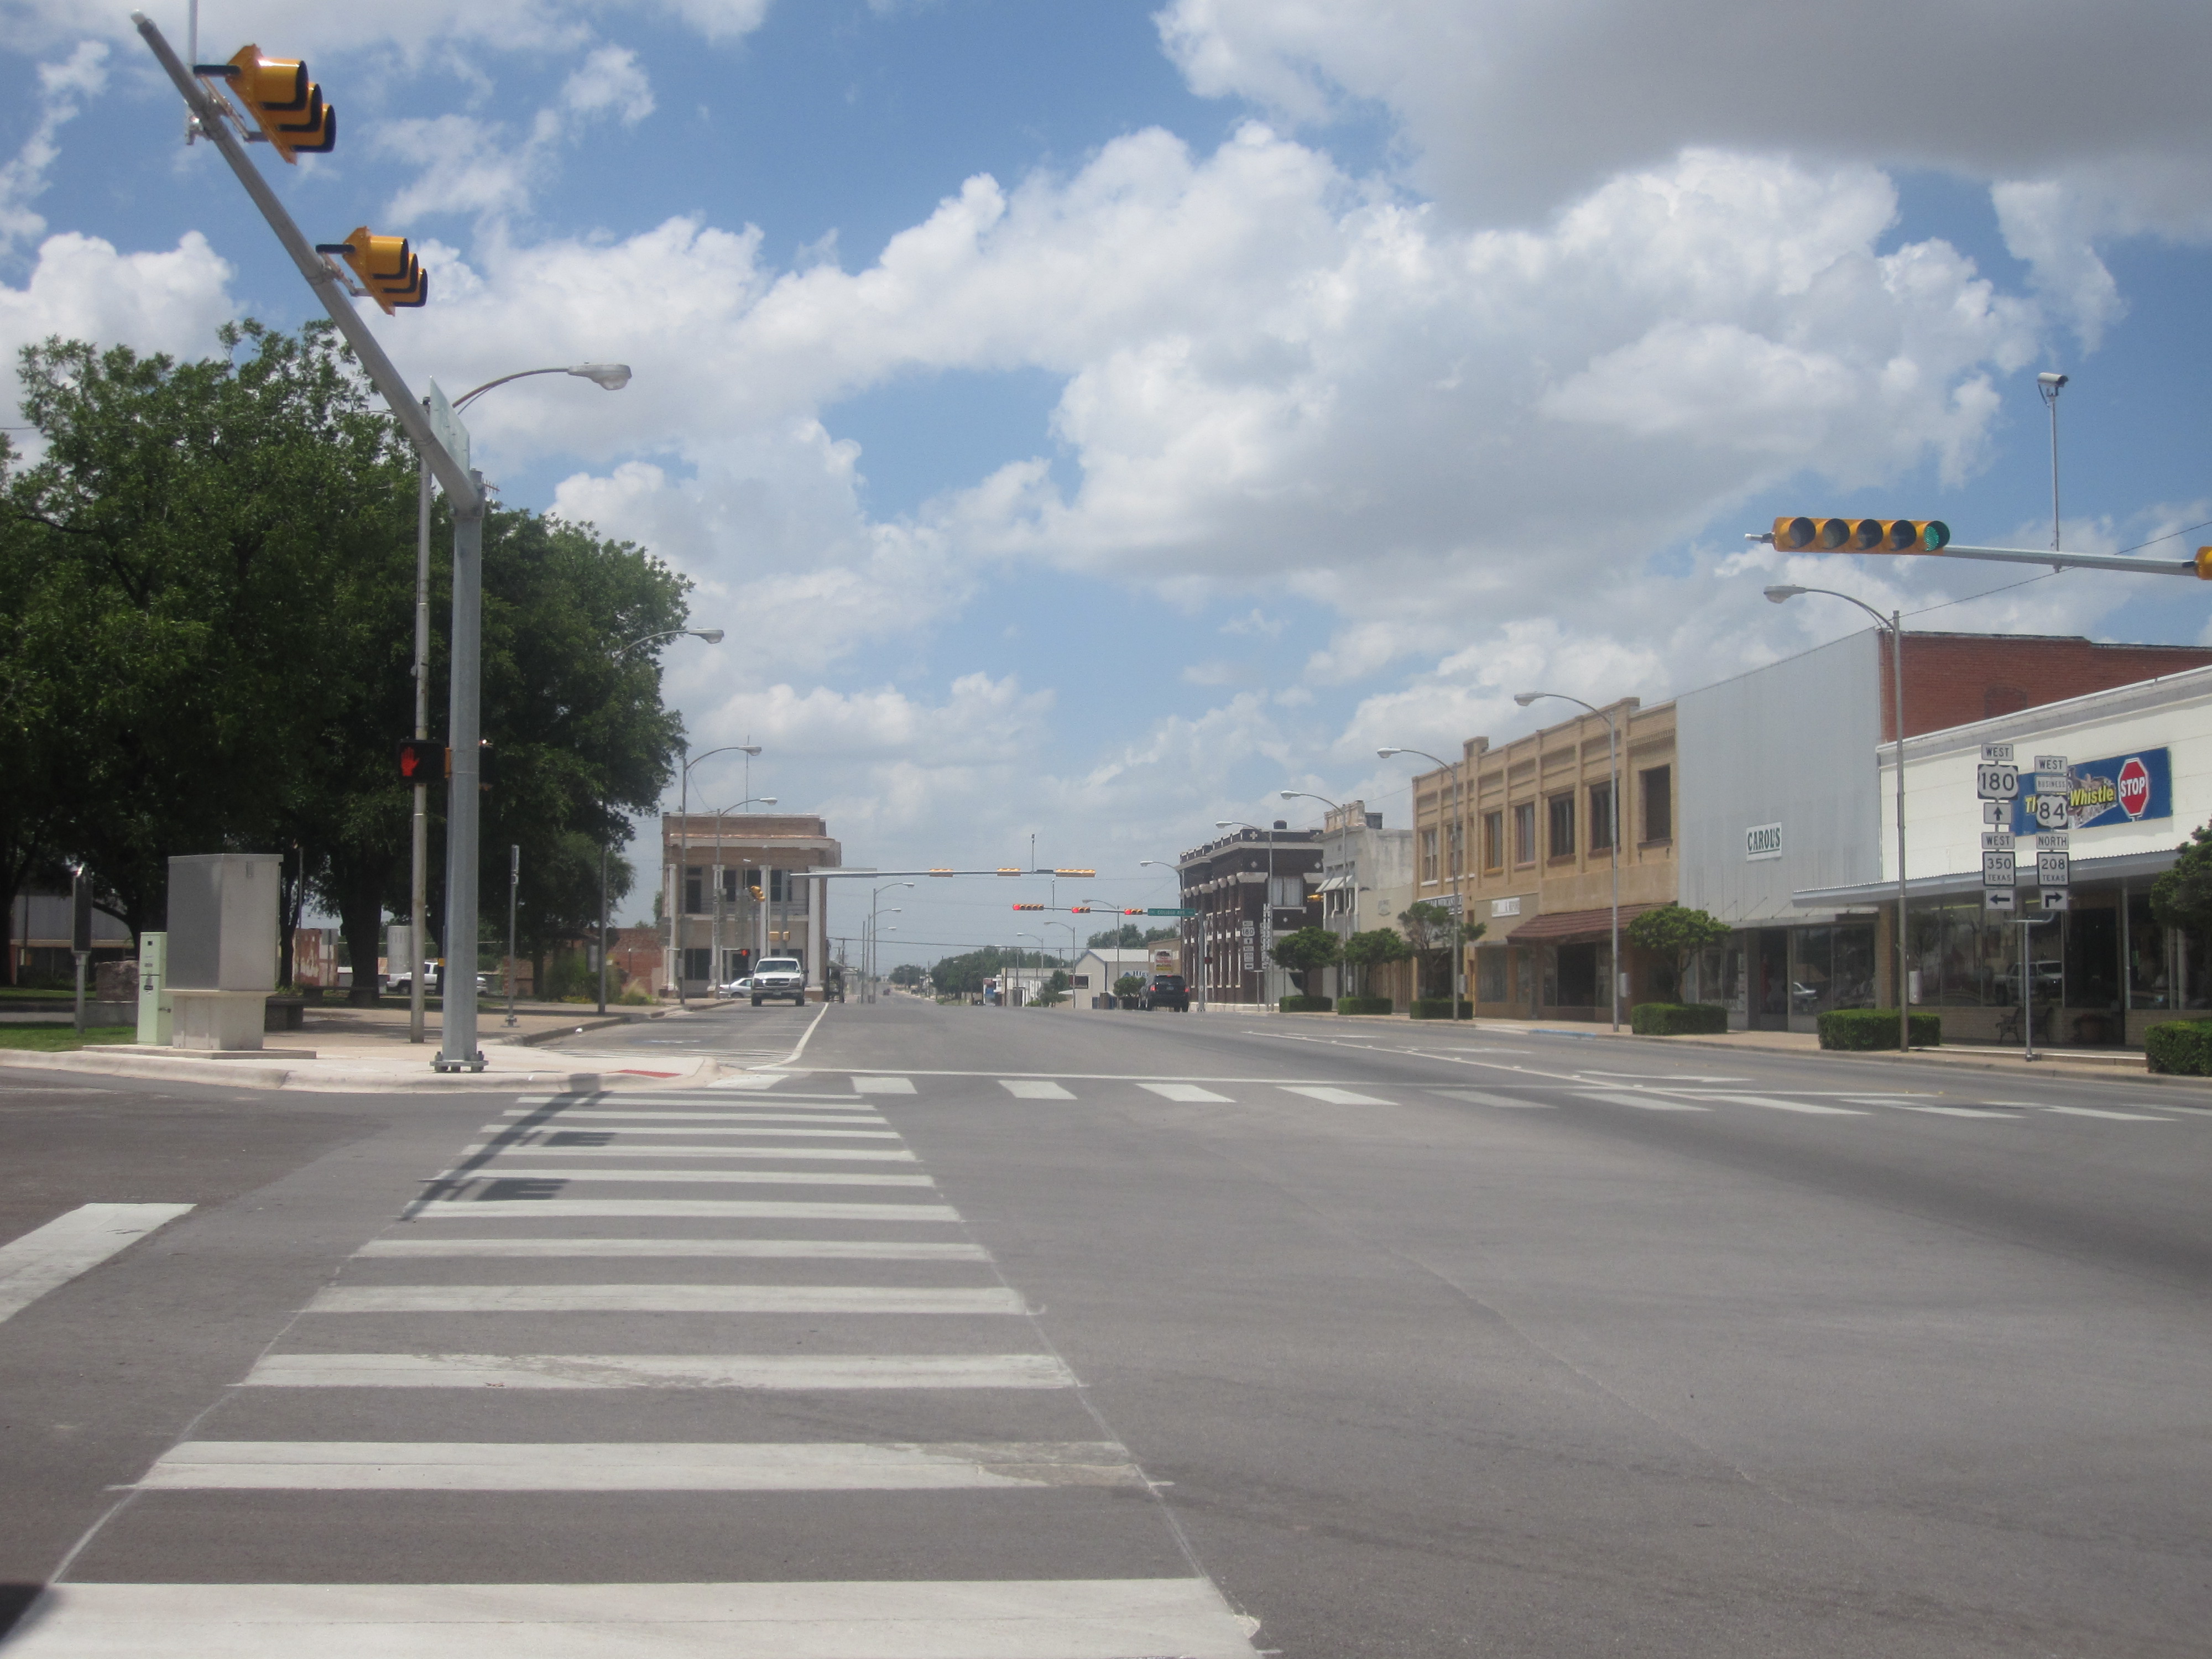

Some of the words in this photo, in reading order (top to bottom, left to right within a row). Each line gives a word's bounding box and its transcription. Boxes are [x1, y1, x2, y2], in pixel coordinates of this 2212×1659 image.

[1986, 747, 2009, 757] WEST
[2039, 760, 2063, 769] WEST
[1982, 773, 2014, 791] 180
[2070, 785, 2114, 807] Whistle
[2120, 776, 2145, 797] STOP
[2039, 802, 2064, 820] 84
[1747, 827, 1780, 852] CAROL'S
[1986, 836, 2010, 846] WEST
[2038, 836, 2067, 846] NORTH
[1987, 858, 2011, 869] 350
[2042, 859, 2065, 869] 208
